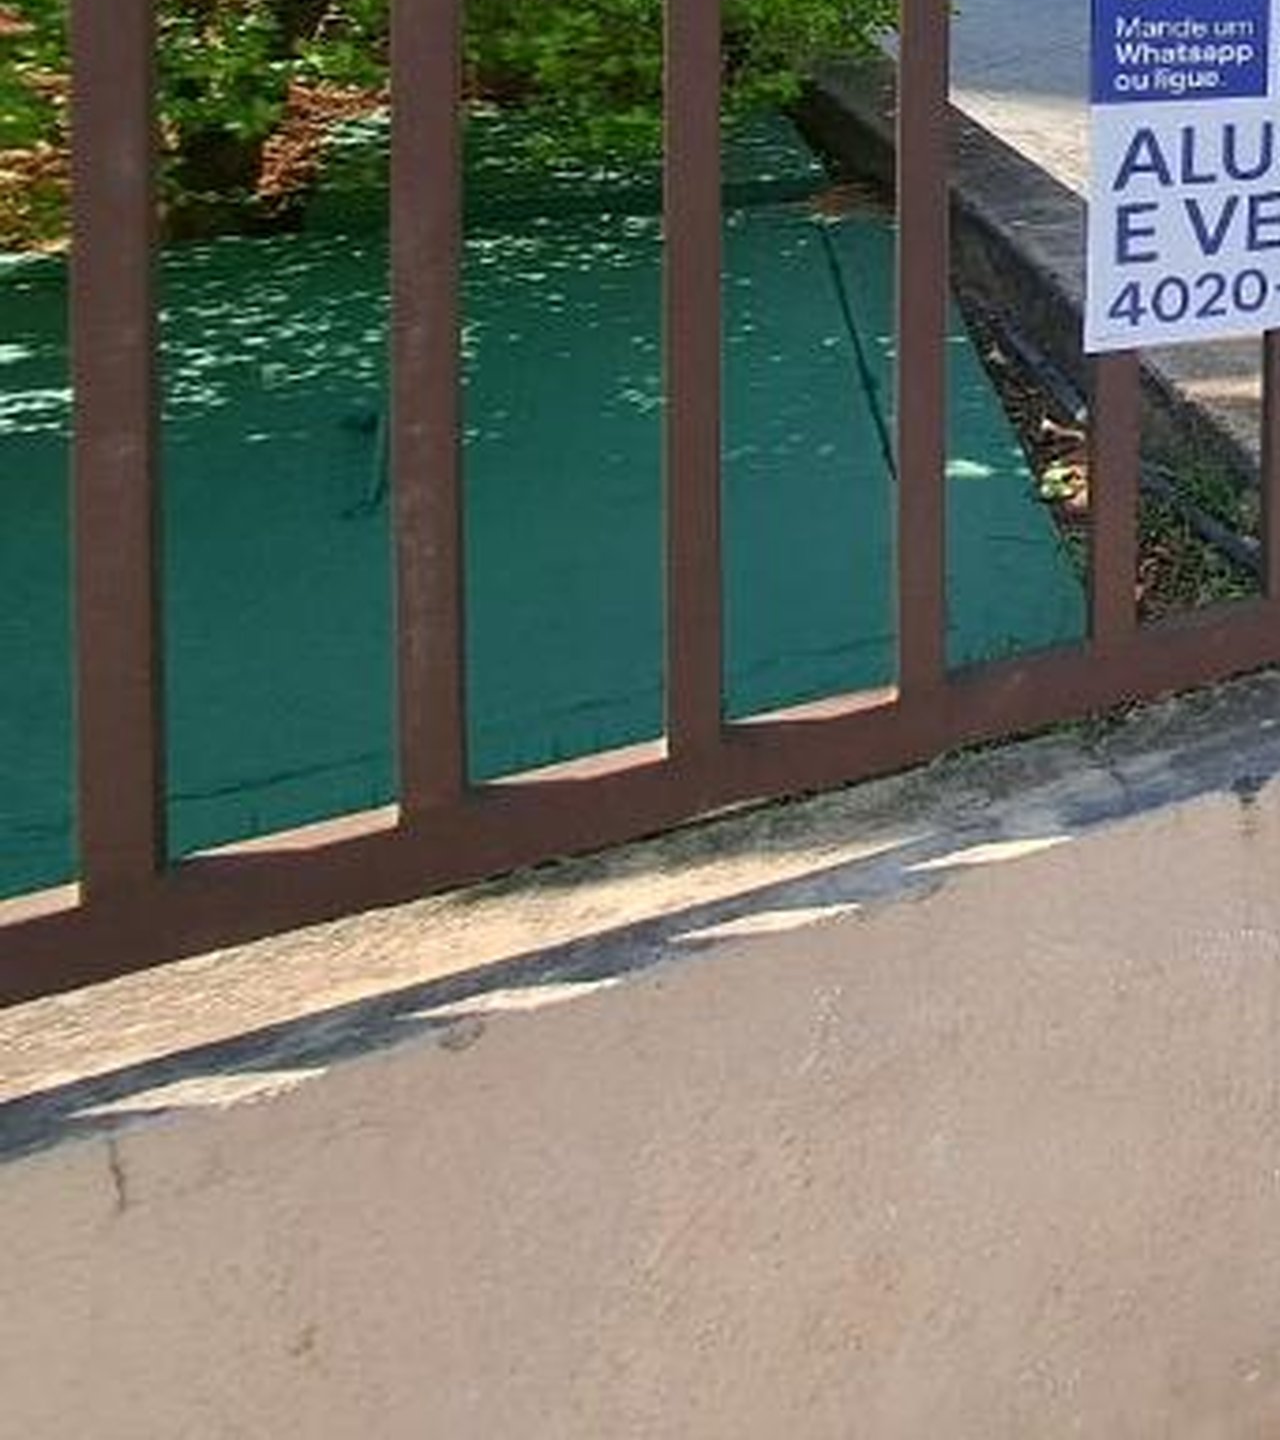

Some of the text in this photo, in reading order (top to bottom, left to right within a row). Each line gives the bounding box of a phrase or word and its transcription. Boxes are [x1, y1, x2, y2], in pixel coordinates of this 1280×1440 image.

[1115, 16, 1254, 38] Mande um
[1114, 72, 1149, 92] ou
[1115, 201, 1158, 265] E
